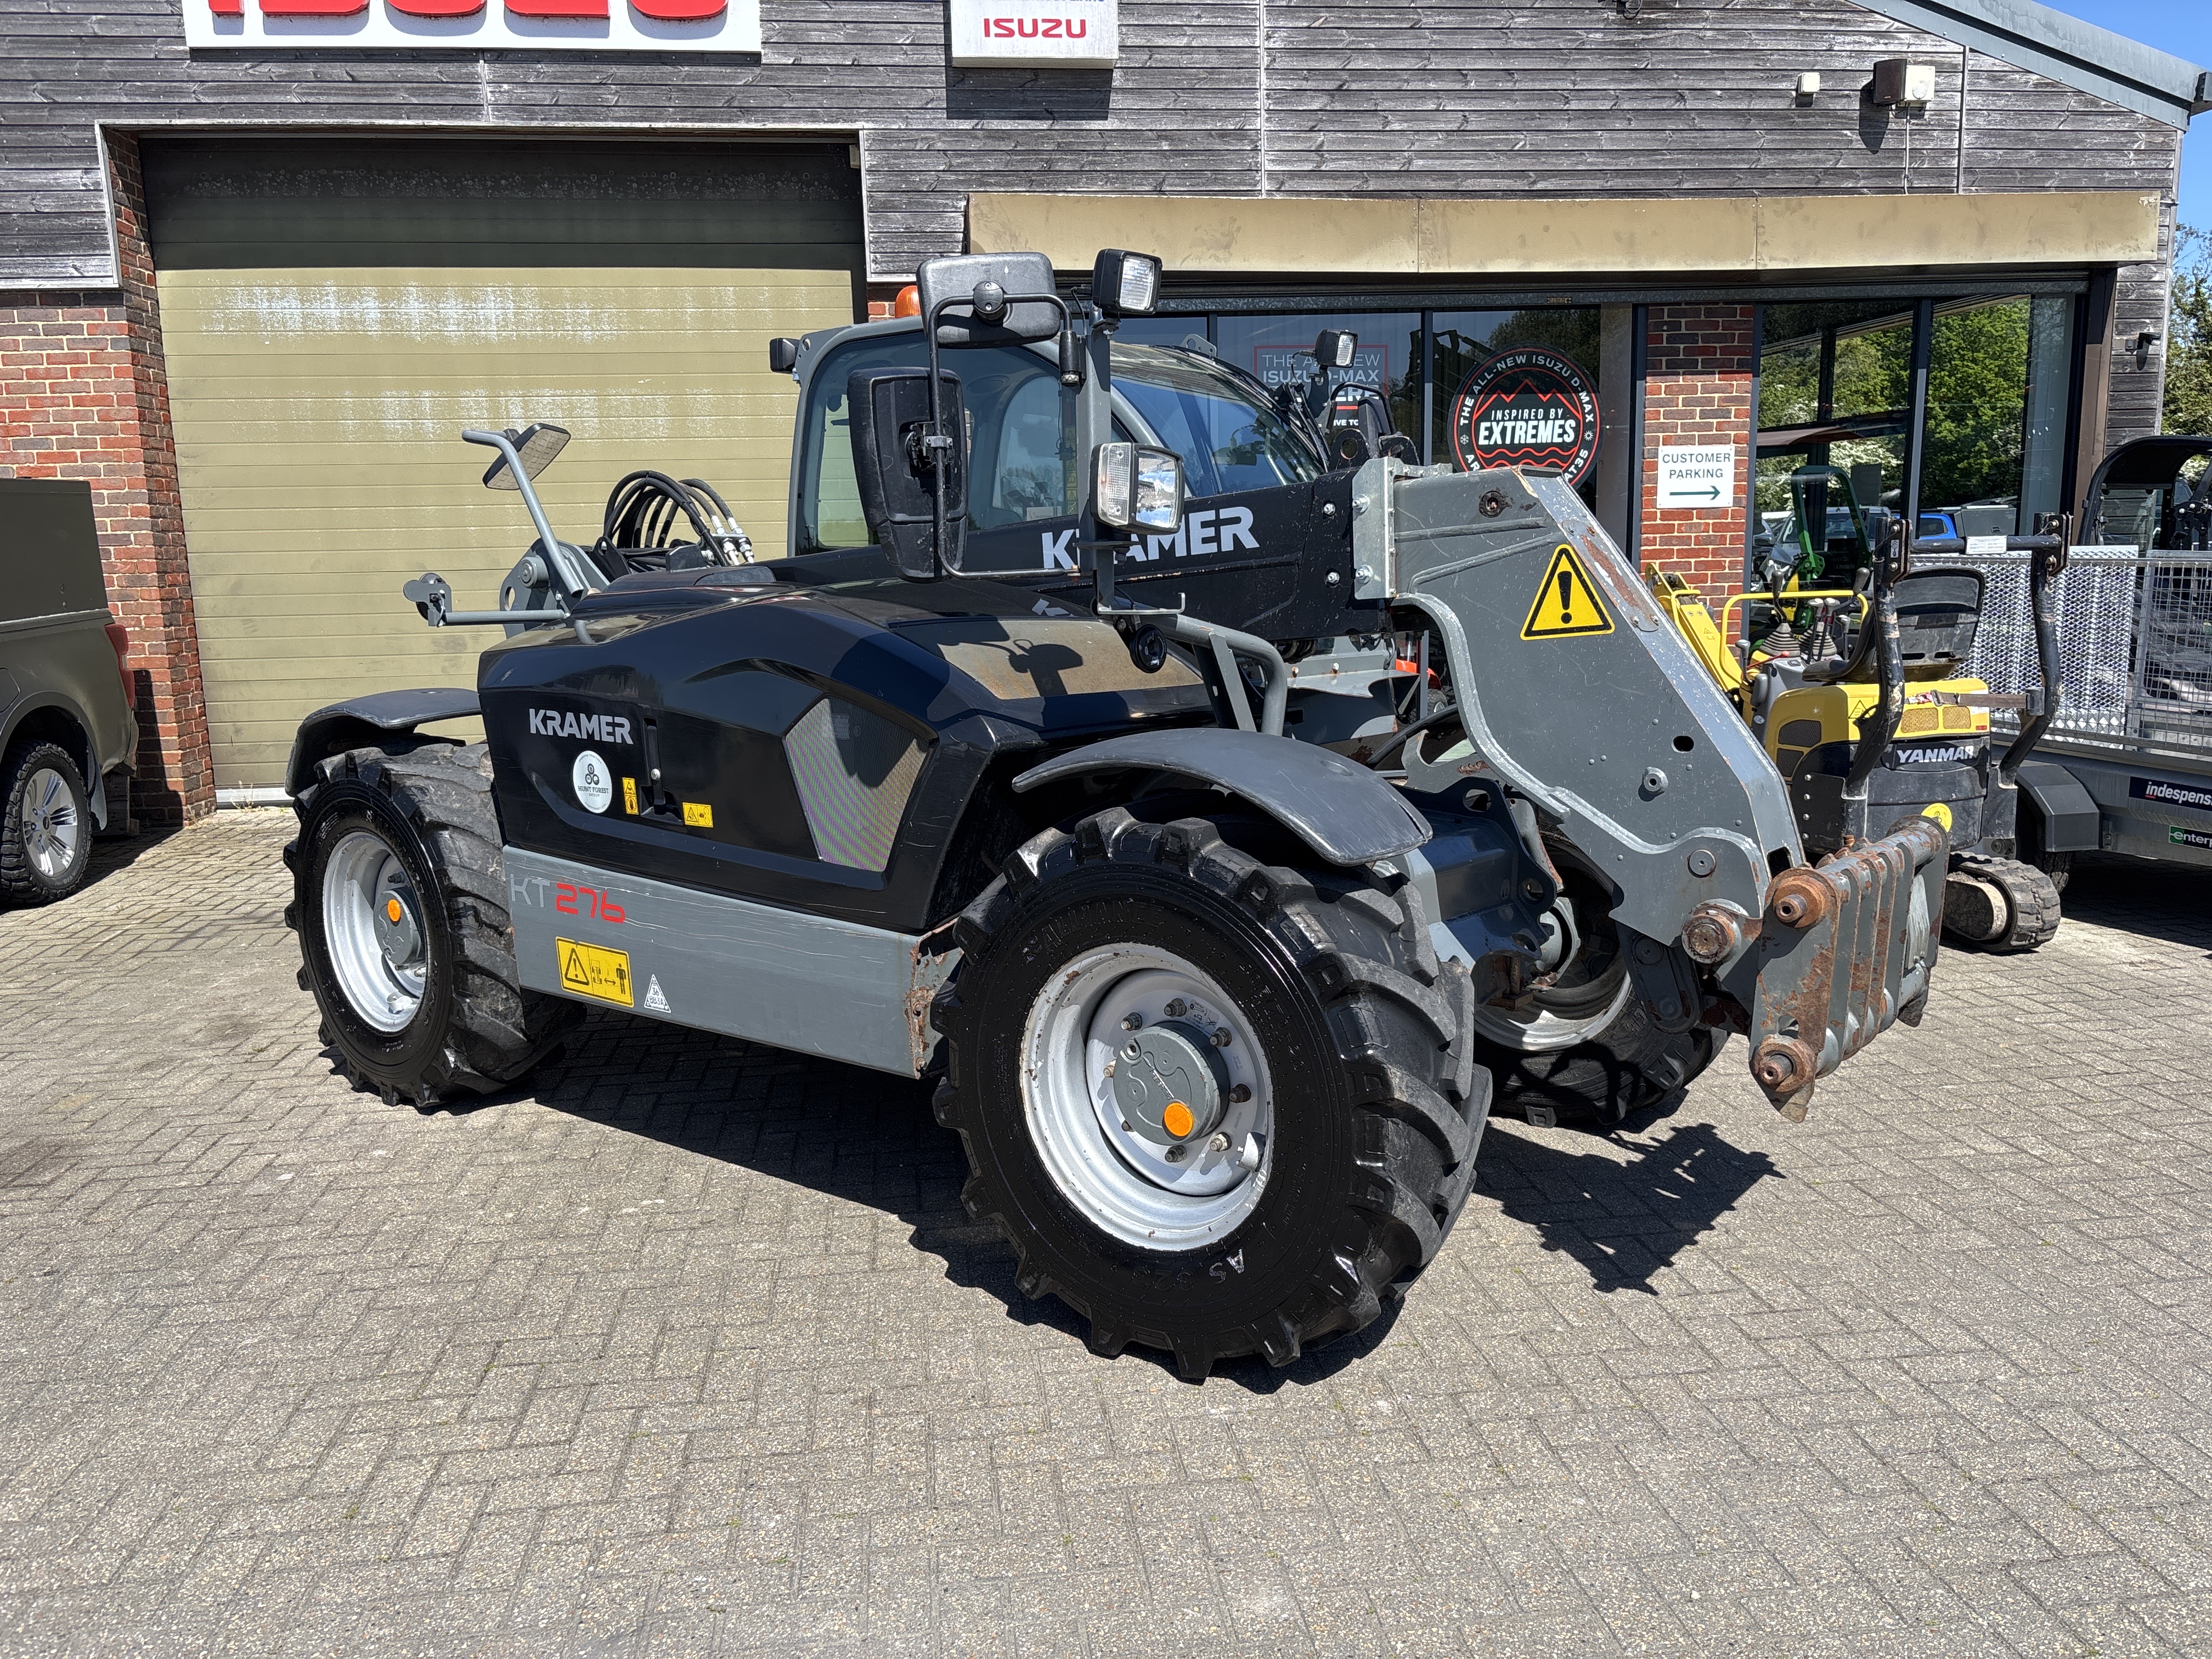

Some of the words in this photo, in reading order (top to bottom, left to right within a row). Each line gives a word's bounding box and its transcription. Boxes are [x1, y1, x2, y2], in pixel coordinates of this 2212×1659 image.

[984, 18, 1086, 38] ISUZU
[1261, 354, 1297, 368] THE
[1460, 396, 1475, 426] THE
[1472, 354, 1527, 395] ALL-NEW
[1532, 355, 1571, 377] ISUZU
[1570, 377, 1594, 423] D-MAX
[1491, 408, 1544, 421] INSPIRED
[1549, 408, 1564, 419] BY
[1478, 419, 1576, 445] EXTREMES
[1662, 453, 1731, 464] CUSTOMER
[1669, 468, 1724, 479] PARKING
[1042, 506, 1260, 570] KAMER
[529, 708, 634, 745] KRAMER
[1897, 745, 1974, 764] YANMAR
[592, 786, 610, 794] FOREST
[2146, 781, 2212, 806] indespens
[510, 873, 550, 908] KT
[555, 882, 626, 923] 276
